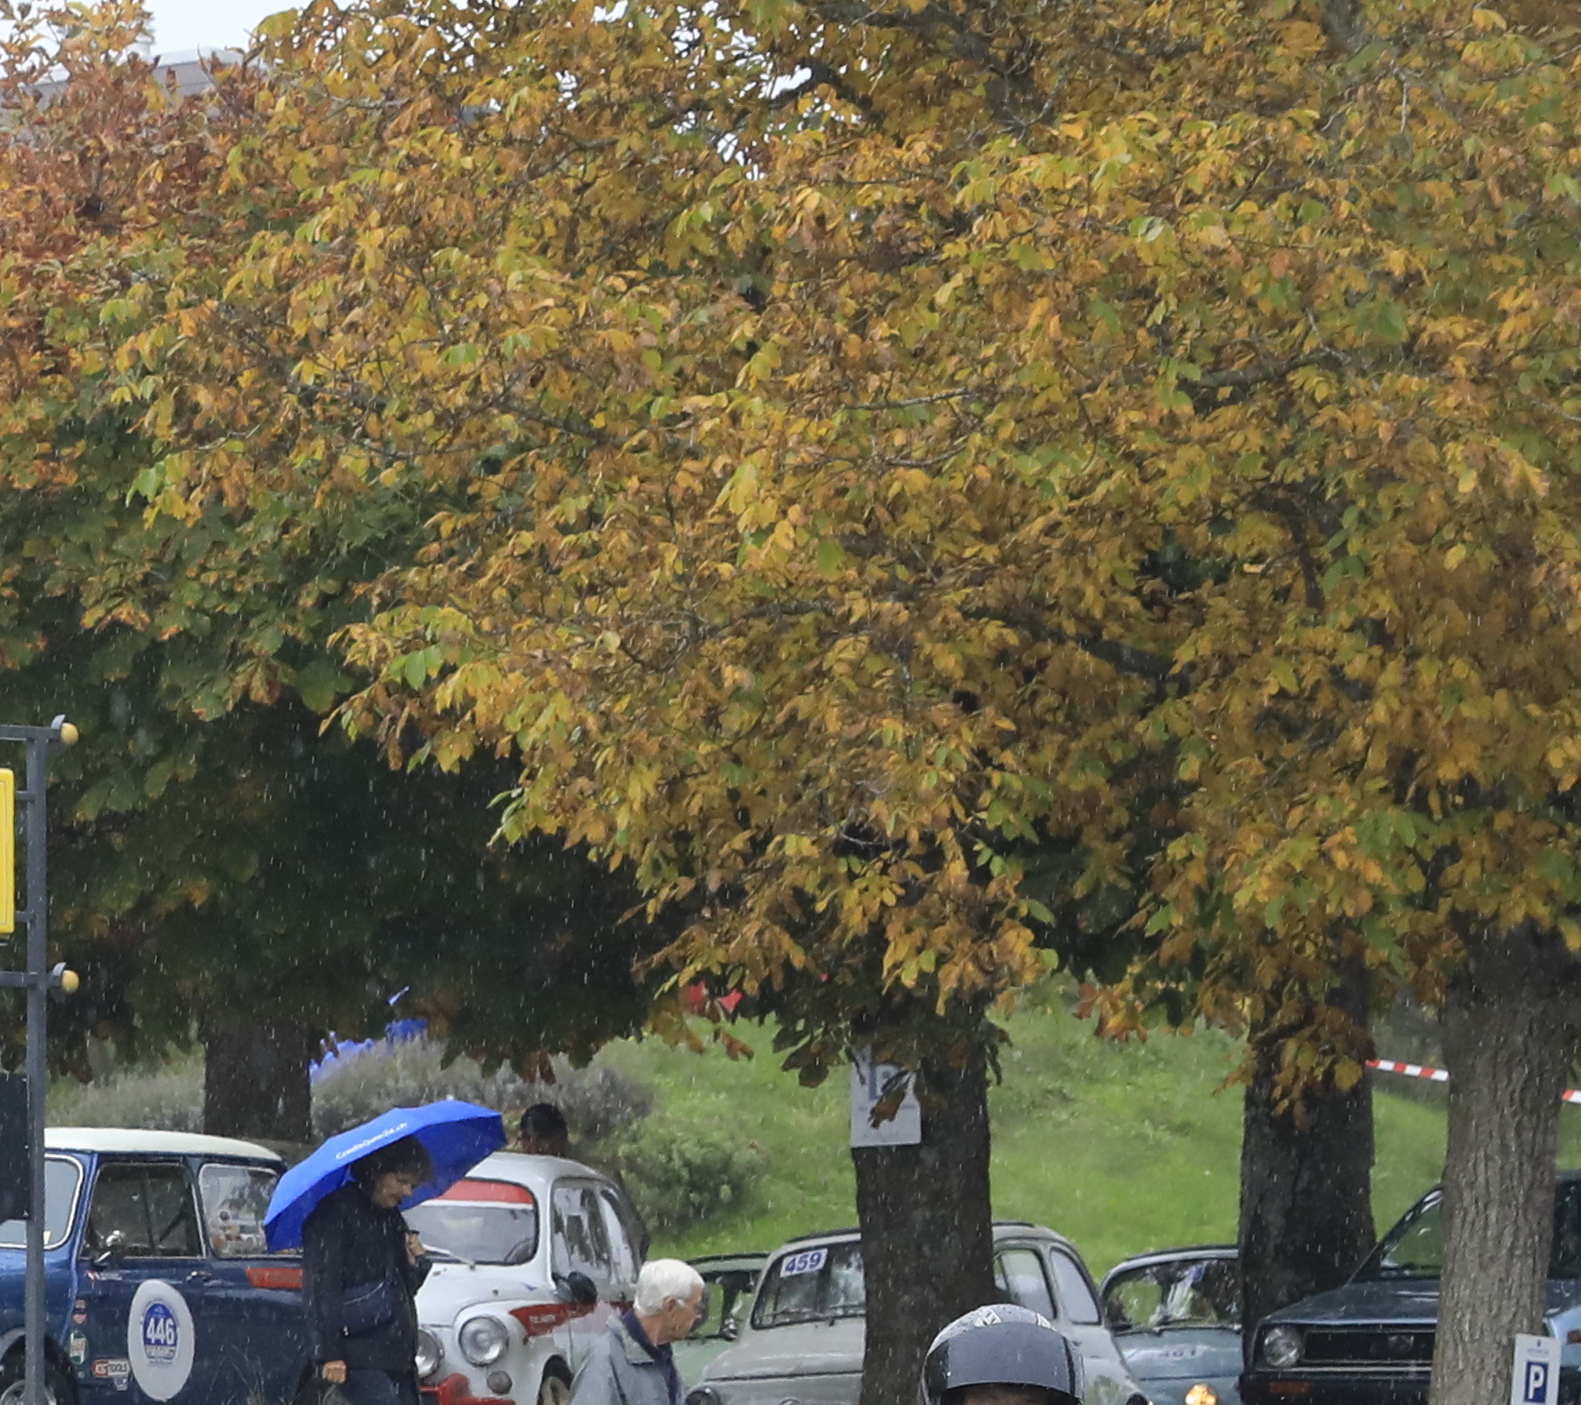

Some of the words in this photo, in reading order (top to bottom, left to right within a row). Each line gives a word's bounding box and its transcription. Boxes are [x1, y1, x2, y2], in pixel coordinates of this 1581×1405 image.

[784, 1251, 822, 1275] 459
[146, 1317, 174, 1345] 446
[1528, 1364, 1545, 1400] P
